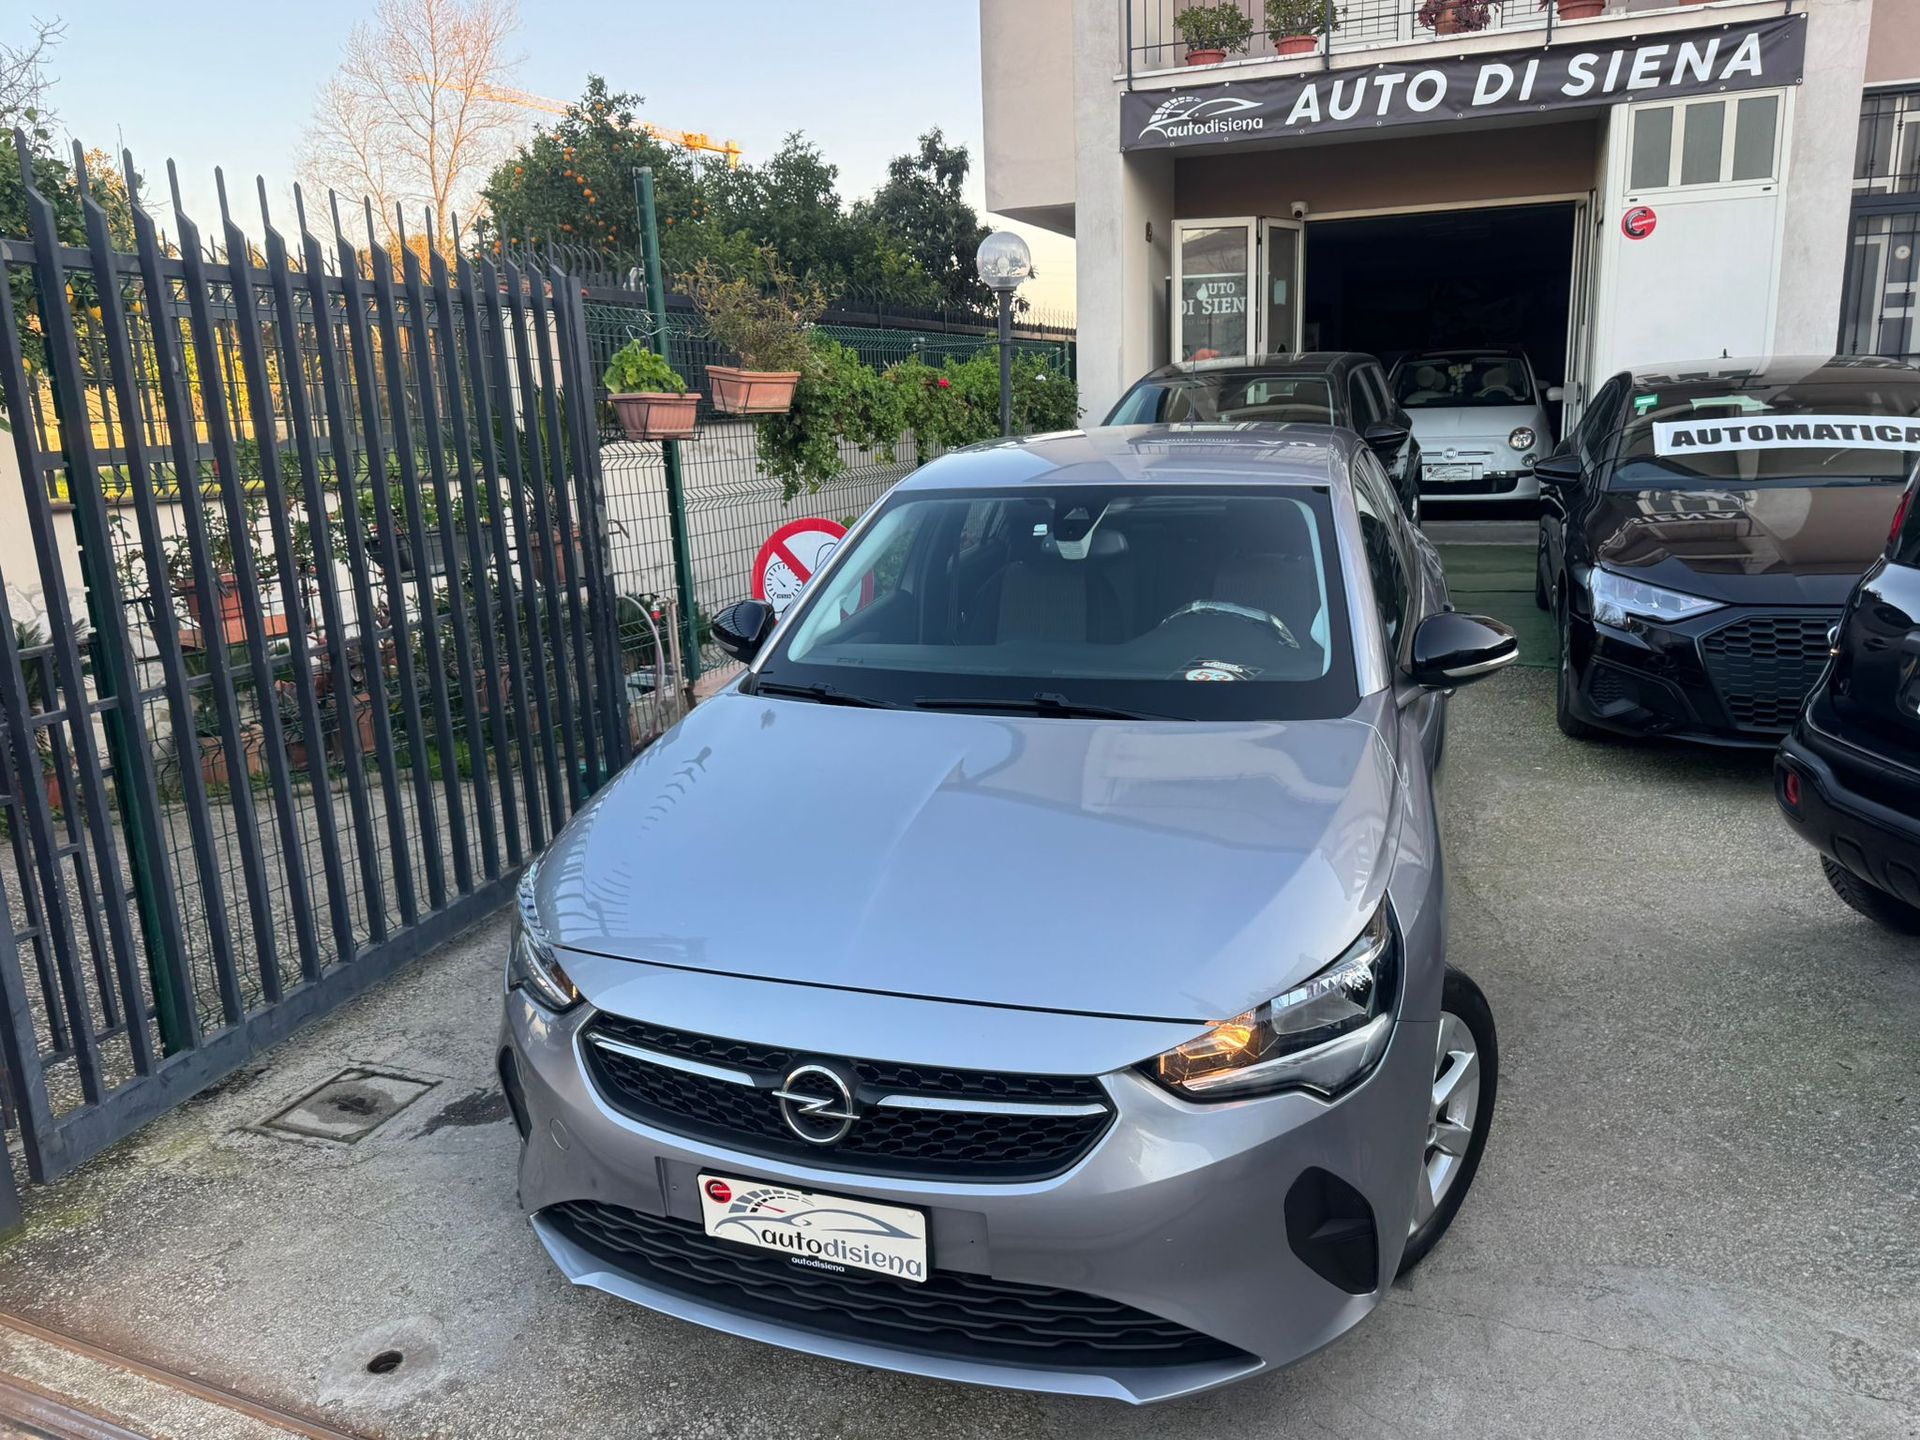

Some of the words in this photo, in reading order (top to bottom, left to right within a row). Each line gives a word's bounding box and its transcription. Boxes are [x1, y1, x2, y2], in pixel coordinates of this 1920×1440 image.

[1285, 69, 1448, 125] AUTO
[1471, 59, 1540, 106] DI
[1561, 32, 1763, 97] SIENA
[1167, 117, 1264, 138] autodisiena
[1202, 297, 1247, 315] SIEN
[761, 1229, 922, 1277] autodisiena
[791, 1256, 845, 1273] autodisiena
